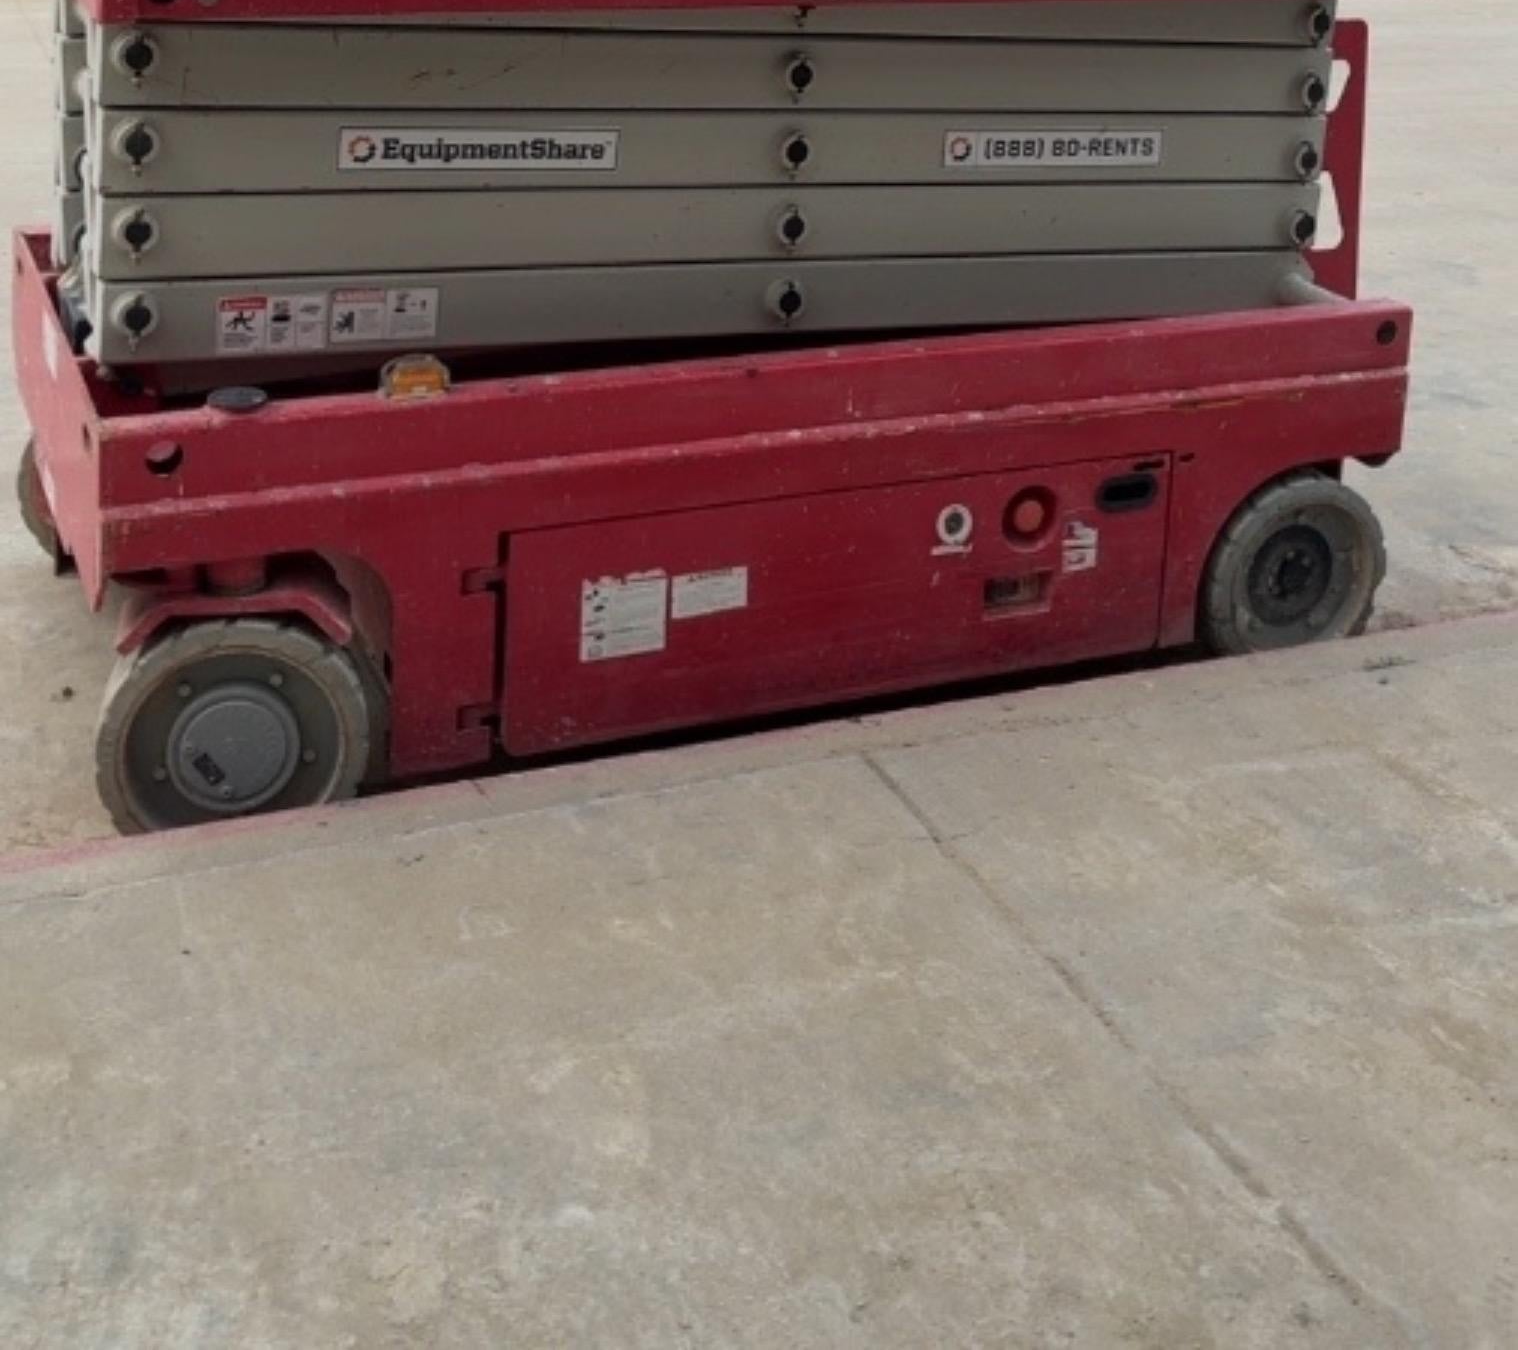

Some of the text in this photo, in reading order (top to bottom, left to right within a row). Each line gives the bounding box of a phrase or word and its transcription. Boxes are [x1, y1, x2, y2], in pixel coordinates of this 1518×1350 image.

[381, 137, 606, 164] EquipmentShare
[983, 137, 1154, 160] (888) 80-RENTS
